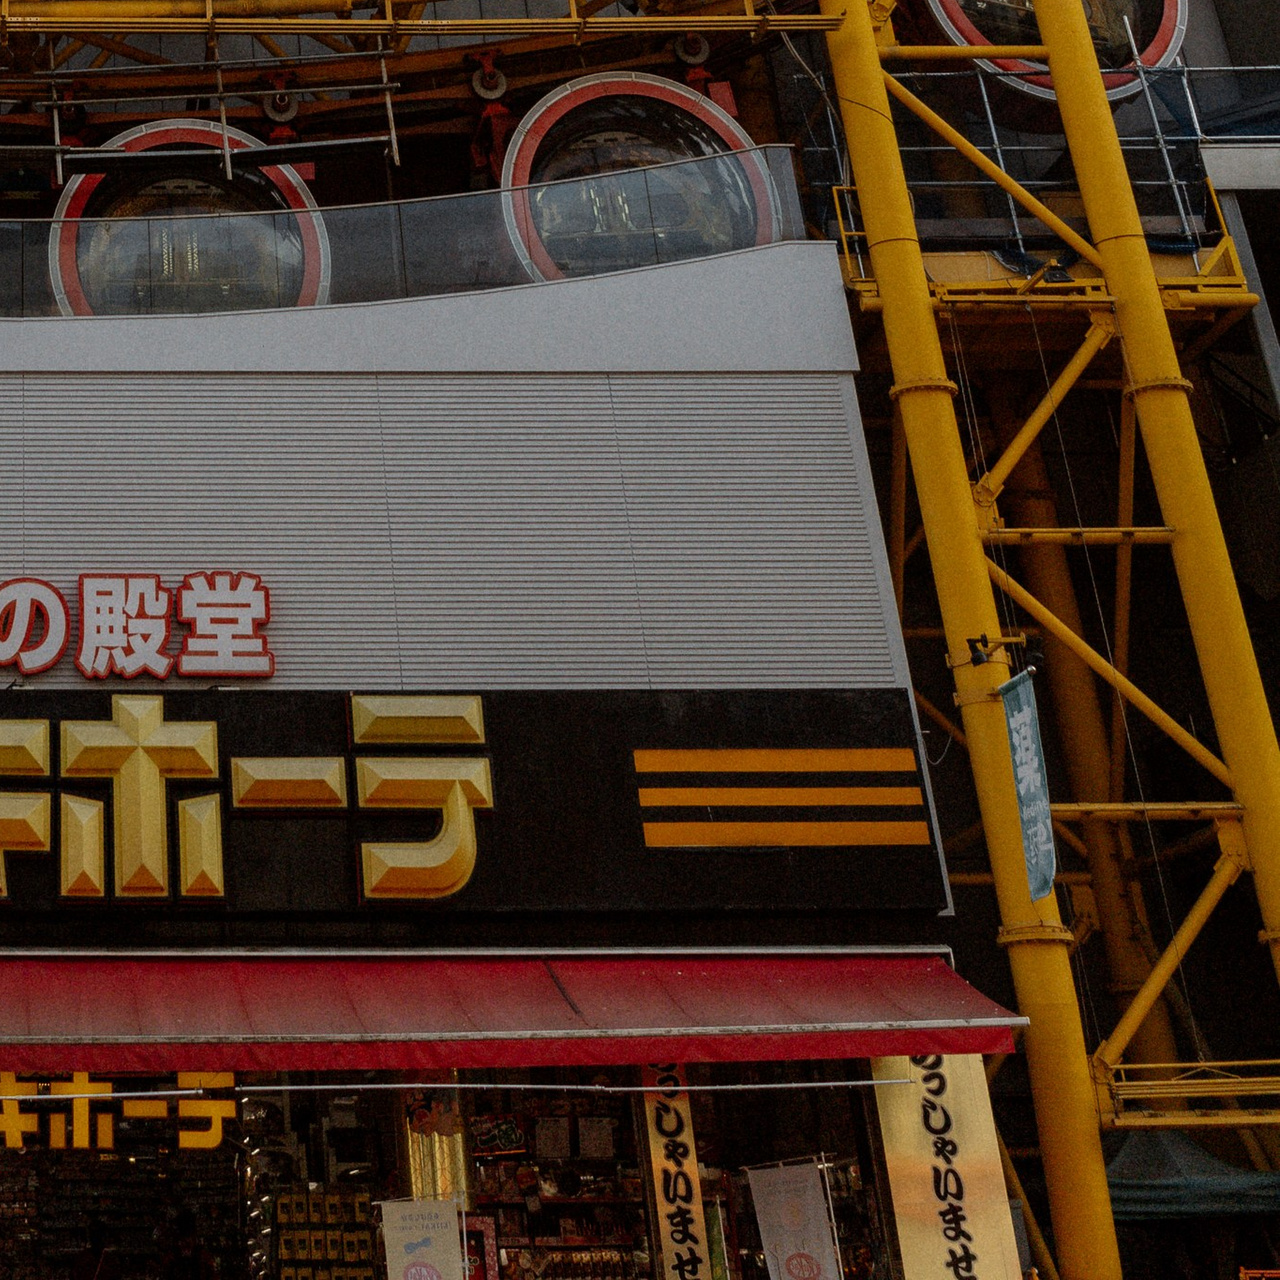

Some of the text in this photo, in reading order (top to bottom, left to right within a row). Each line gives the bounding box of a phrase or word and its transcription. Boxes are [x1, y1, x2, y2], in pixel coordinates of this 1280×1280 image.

[648, 1064, 703, 1280] っしゃいませ
